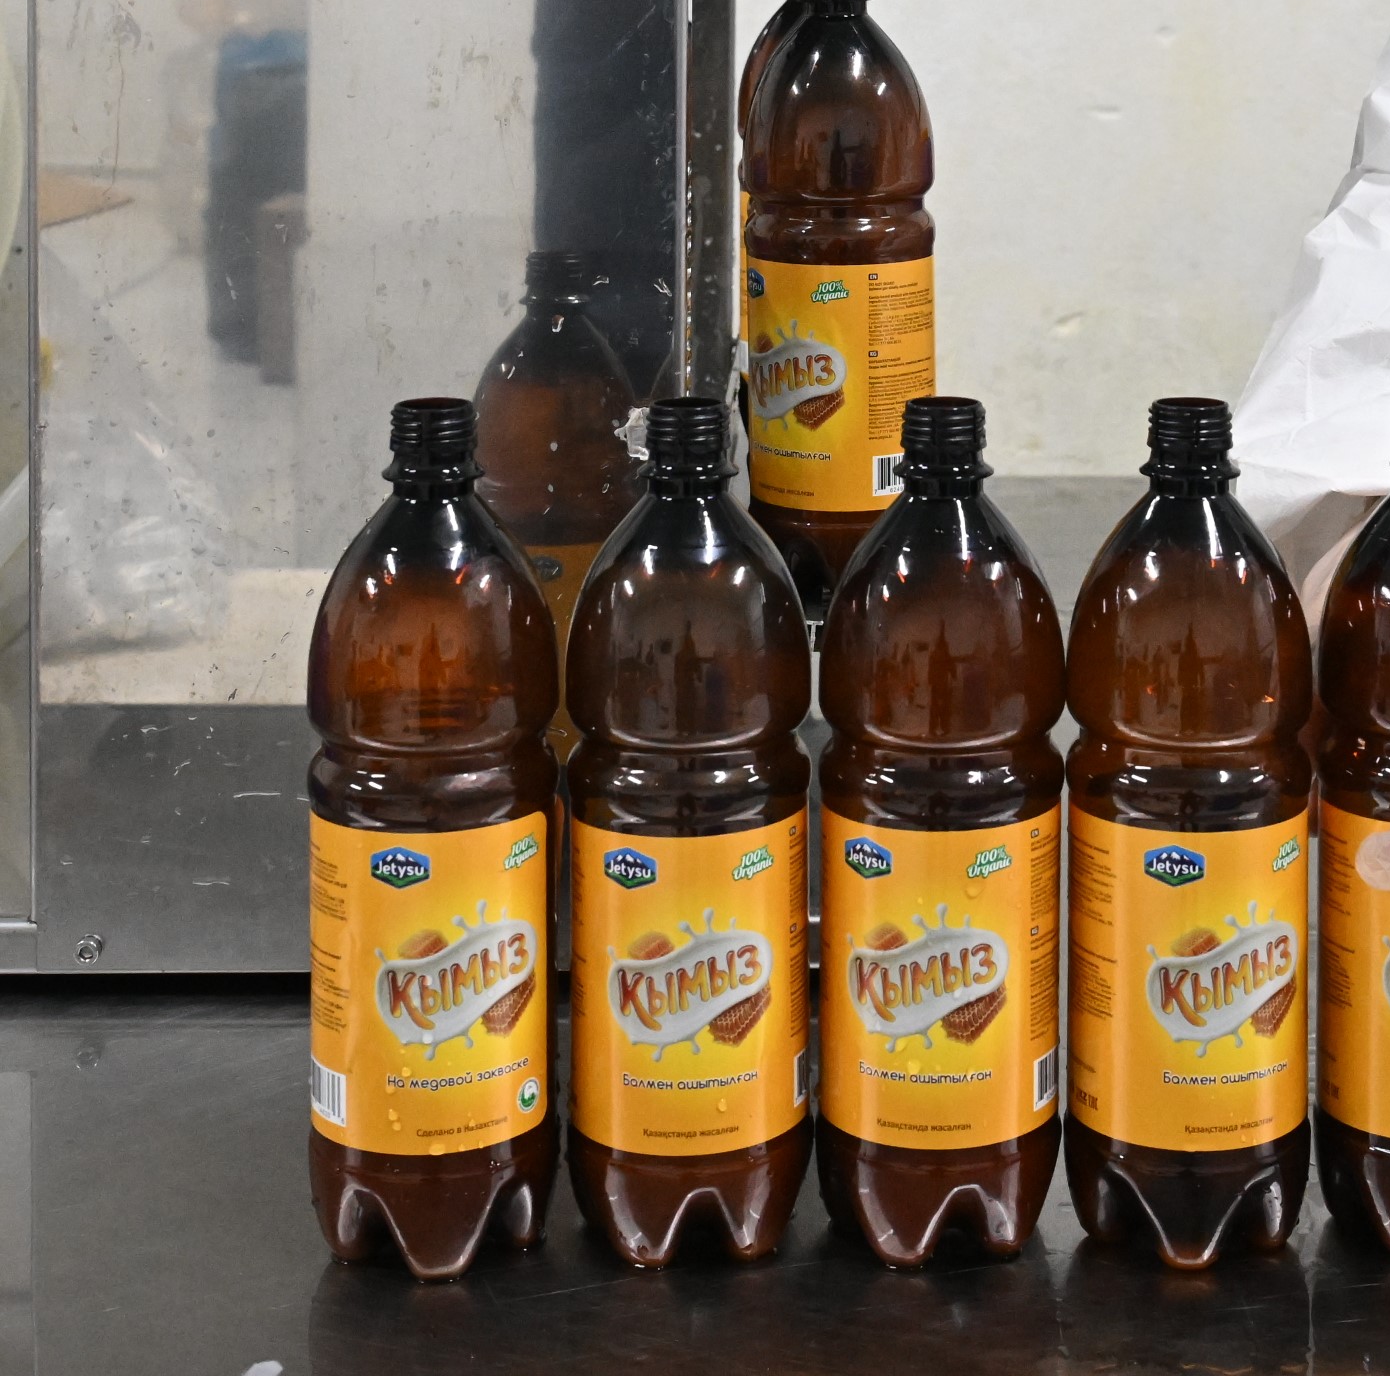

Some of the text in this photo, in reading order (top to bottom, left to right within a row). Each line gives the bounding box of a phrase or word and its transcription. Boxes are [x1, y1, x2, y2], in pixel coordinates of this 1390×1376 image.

[811, 287, 849, 303] Organic
[818, 280, 844, 293] 100%
[774, 448, 831, 461] ашытылған
[741, 847, 769, 867] 100%
[848, 847, 887, 870] Jetysu
[976, 847, 1006, 866] 100%
[375, 860, 425, 879] Jetysu
[608, 859, 651, 878] Jetysu
[733, 856, 774, 881] Organic
[967, 856, 1012, 878] Organic
[1150, 857, 1199, 877] Jetysu
[387, 1057, 530, 1091] На медовой закваске
[623, 1071, 759, 1091] Балмен ашытылған
[859, 1060, 992, 1084] Балмен ашытылған
[1163, 1060, 1288, 1086] Балмен ашытылған
[416, 1127, 455, 1138] Сделано
